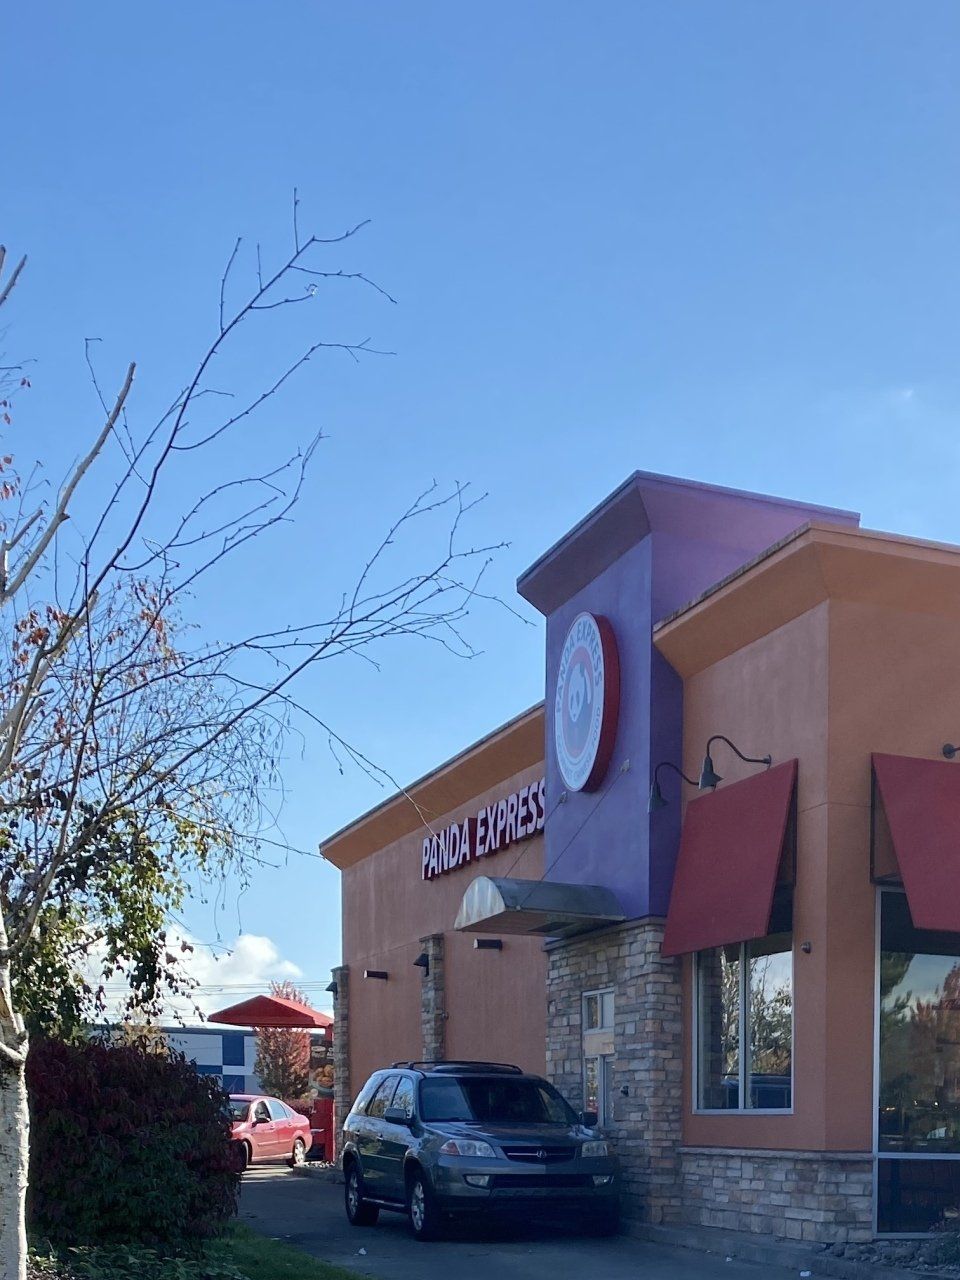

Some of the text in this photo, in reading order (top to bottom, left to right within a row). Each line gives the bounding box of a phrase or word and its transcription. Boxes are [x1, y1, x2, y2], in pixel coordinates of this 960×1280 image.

[577, 620, 602, 687] EXPRESS
[422, 777, 545, 880] PANDA EXPRESS
